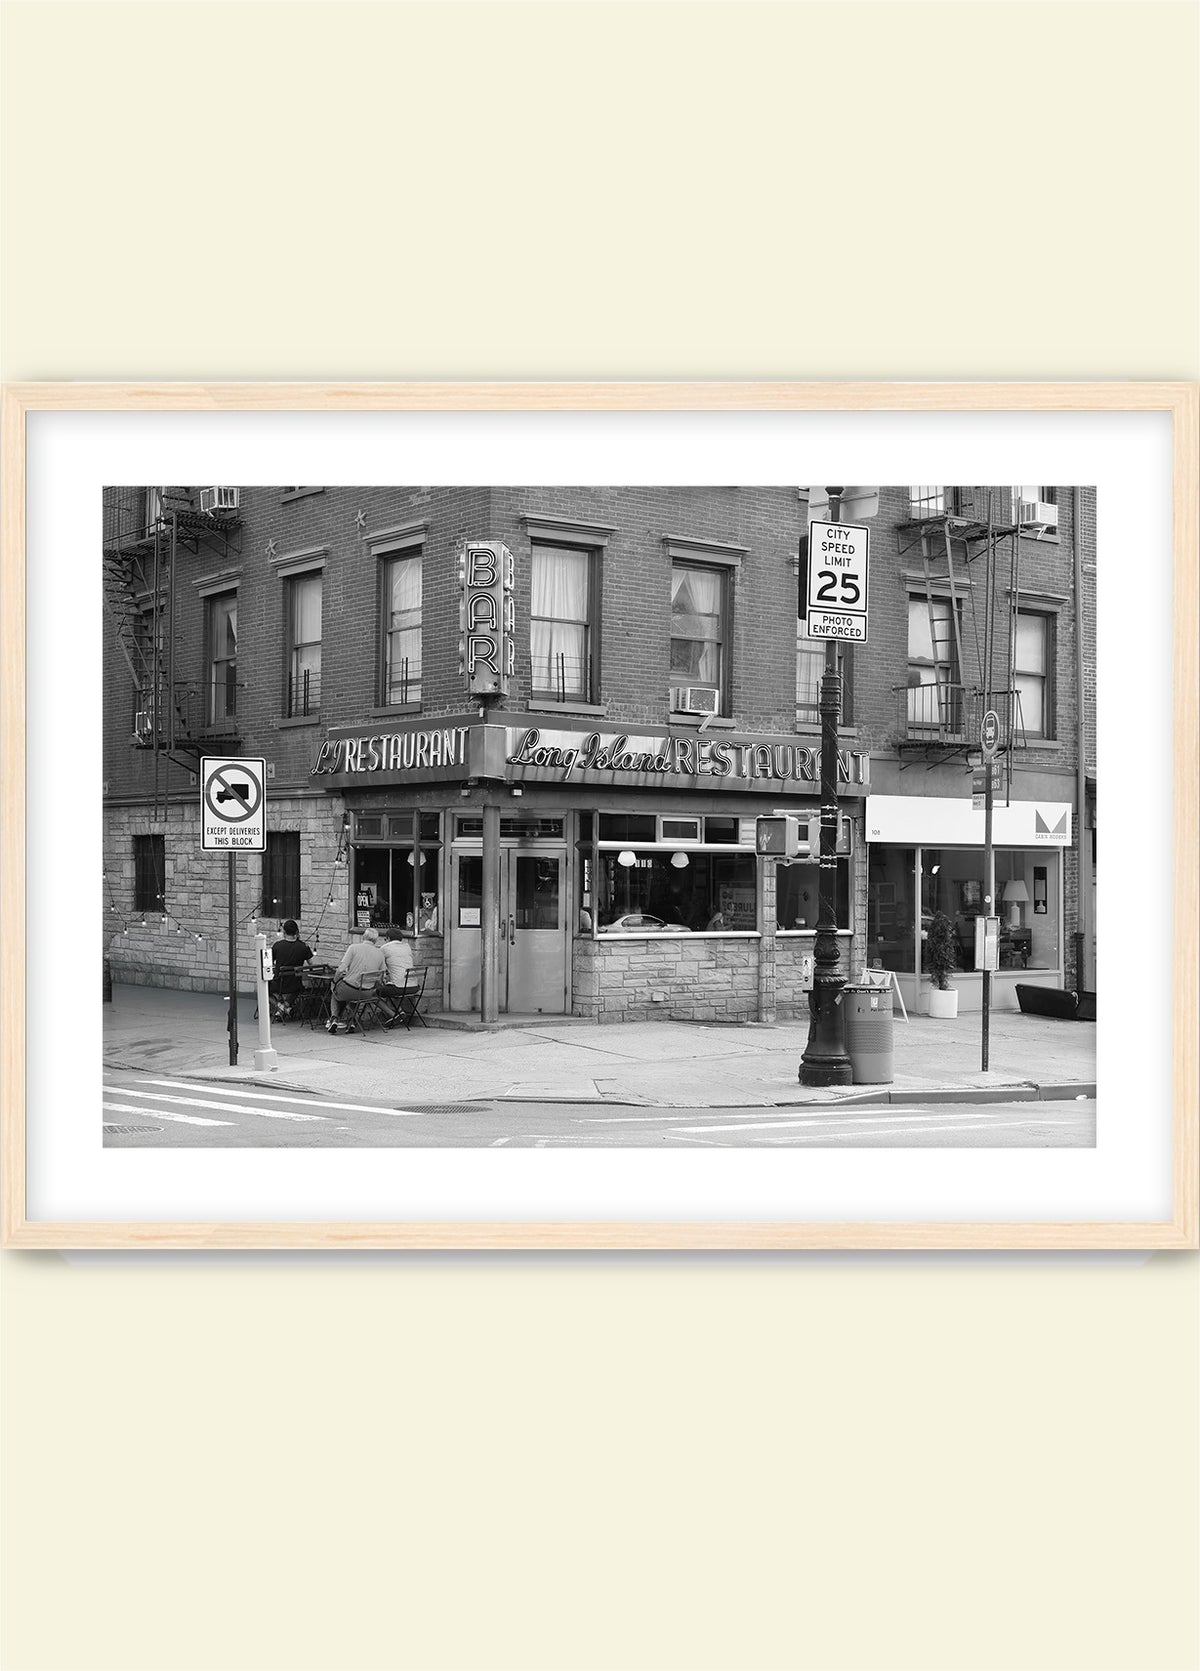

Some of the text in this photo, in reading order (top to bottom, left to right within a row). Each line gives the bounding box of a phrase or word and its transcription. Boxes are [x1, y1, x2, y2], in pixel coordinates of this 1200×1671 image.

[827, 528, 850, 540] CITY
[821, 541, 855, 554] SPEED
[825, 555, 851, 567] LIMIT
[816, 570, 860, 604] 25
[467, 548, 500, 674] BAR
[822, 615, 853, 627] PHOTO
[813, 624, 861, 637] ENFORCED
[345, 726, 469, 773] RESTAURANT
[509, 727, 579, 780] Long
[580, 732, 672, 773] Island
[206, 827, 261, 836] EXCEPT DELIVERIES
[214, 837, 253, 846] THIS BLOCK
